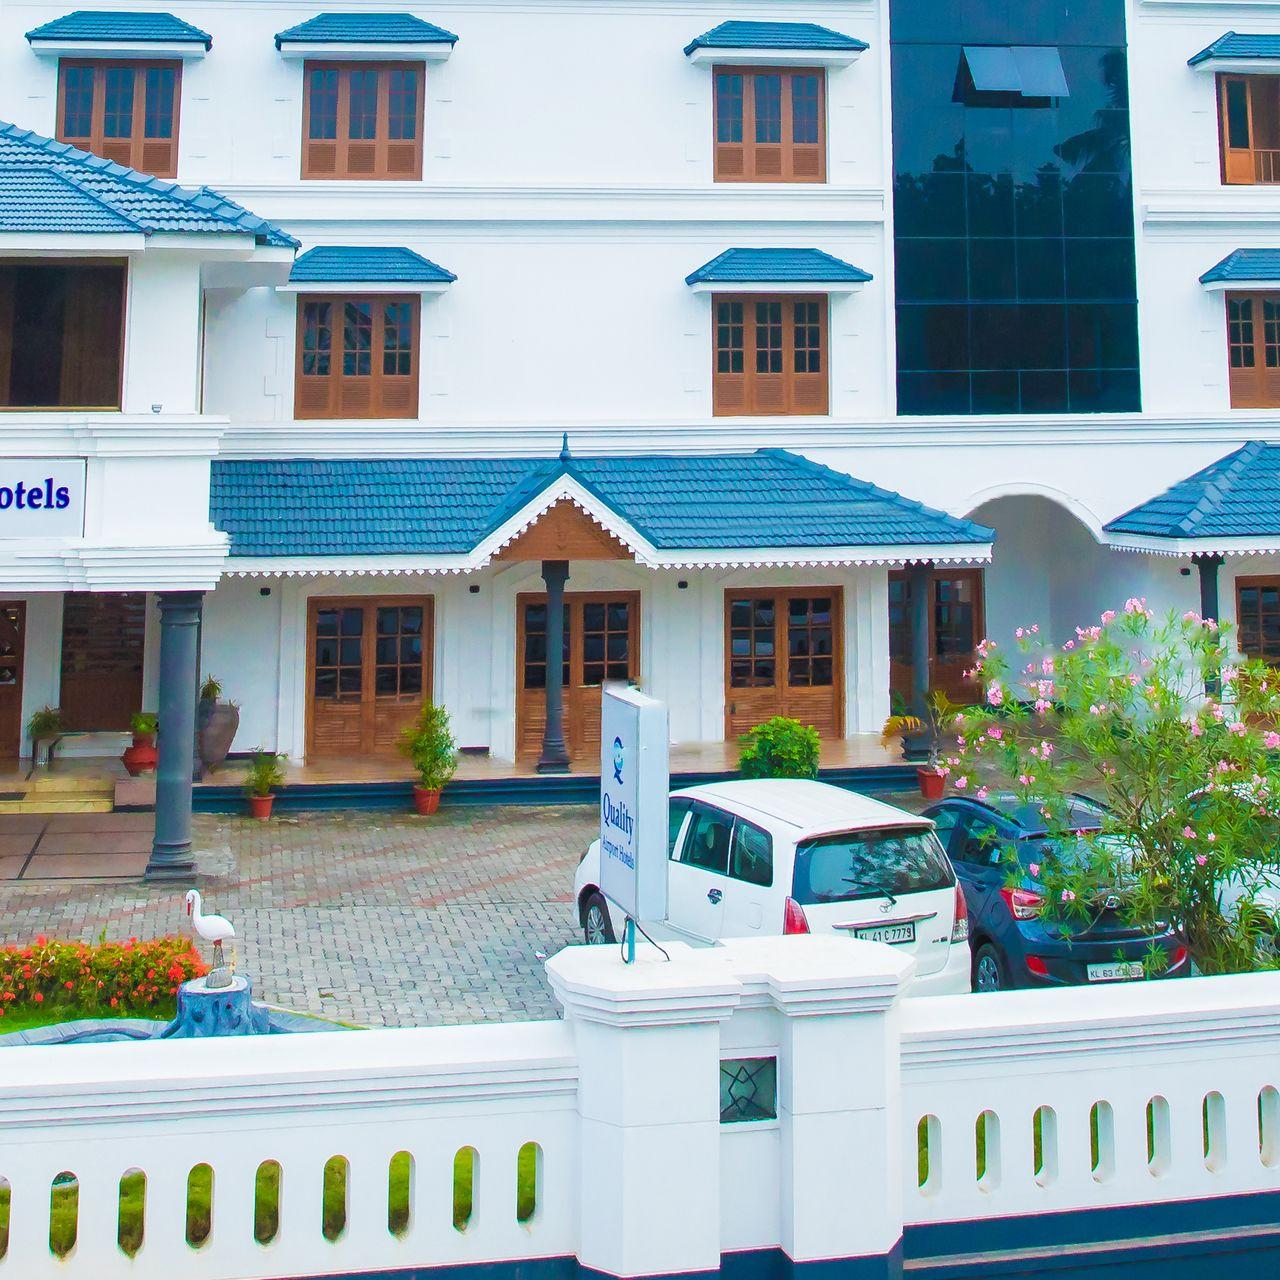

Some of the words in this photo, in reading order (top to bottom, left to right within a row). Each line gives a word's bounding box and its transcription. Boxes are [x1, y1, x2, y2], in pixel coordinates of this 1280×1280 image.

[603, 793, 634, 845] Quality
[891, 927, 912, 939] 7779
[1090, 970, 1101, 978] KL
